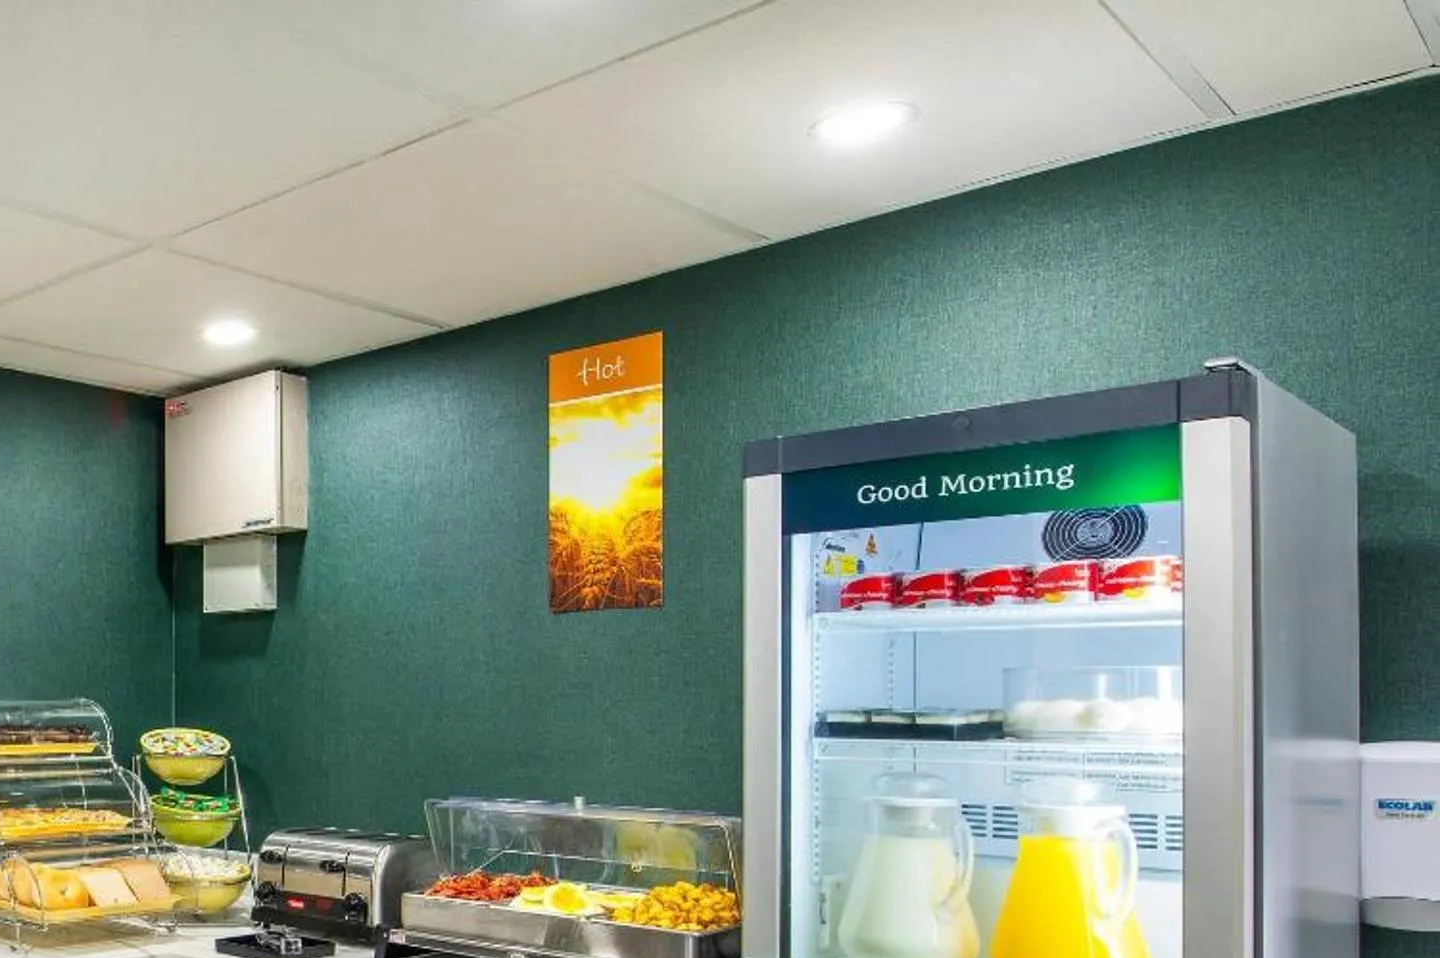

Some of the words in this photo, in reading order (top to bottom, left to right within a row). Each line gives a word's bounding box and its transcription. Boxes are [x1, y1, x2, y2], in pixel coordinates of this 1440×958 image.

[577, 354, 626, 386] Hot
[857, 475, 929, 504] Good
[937, 463, 1075, 497] Morning
